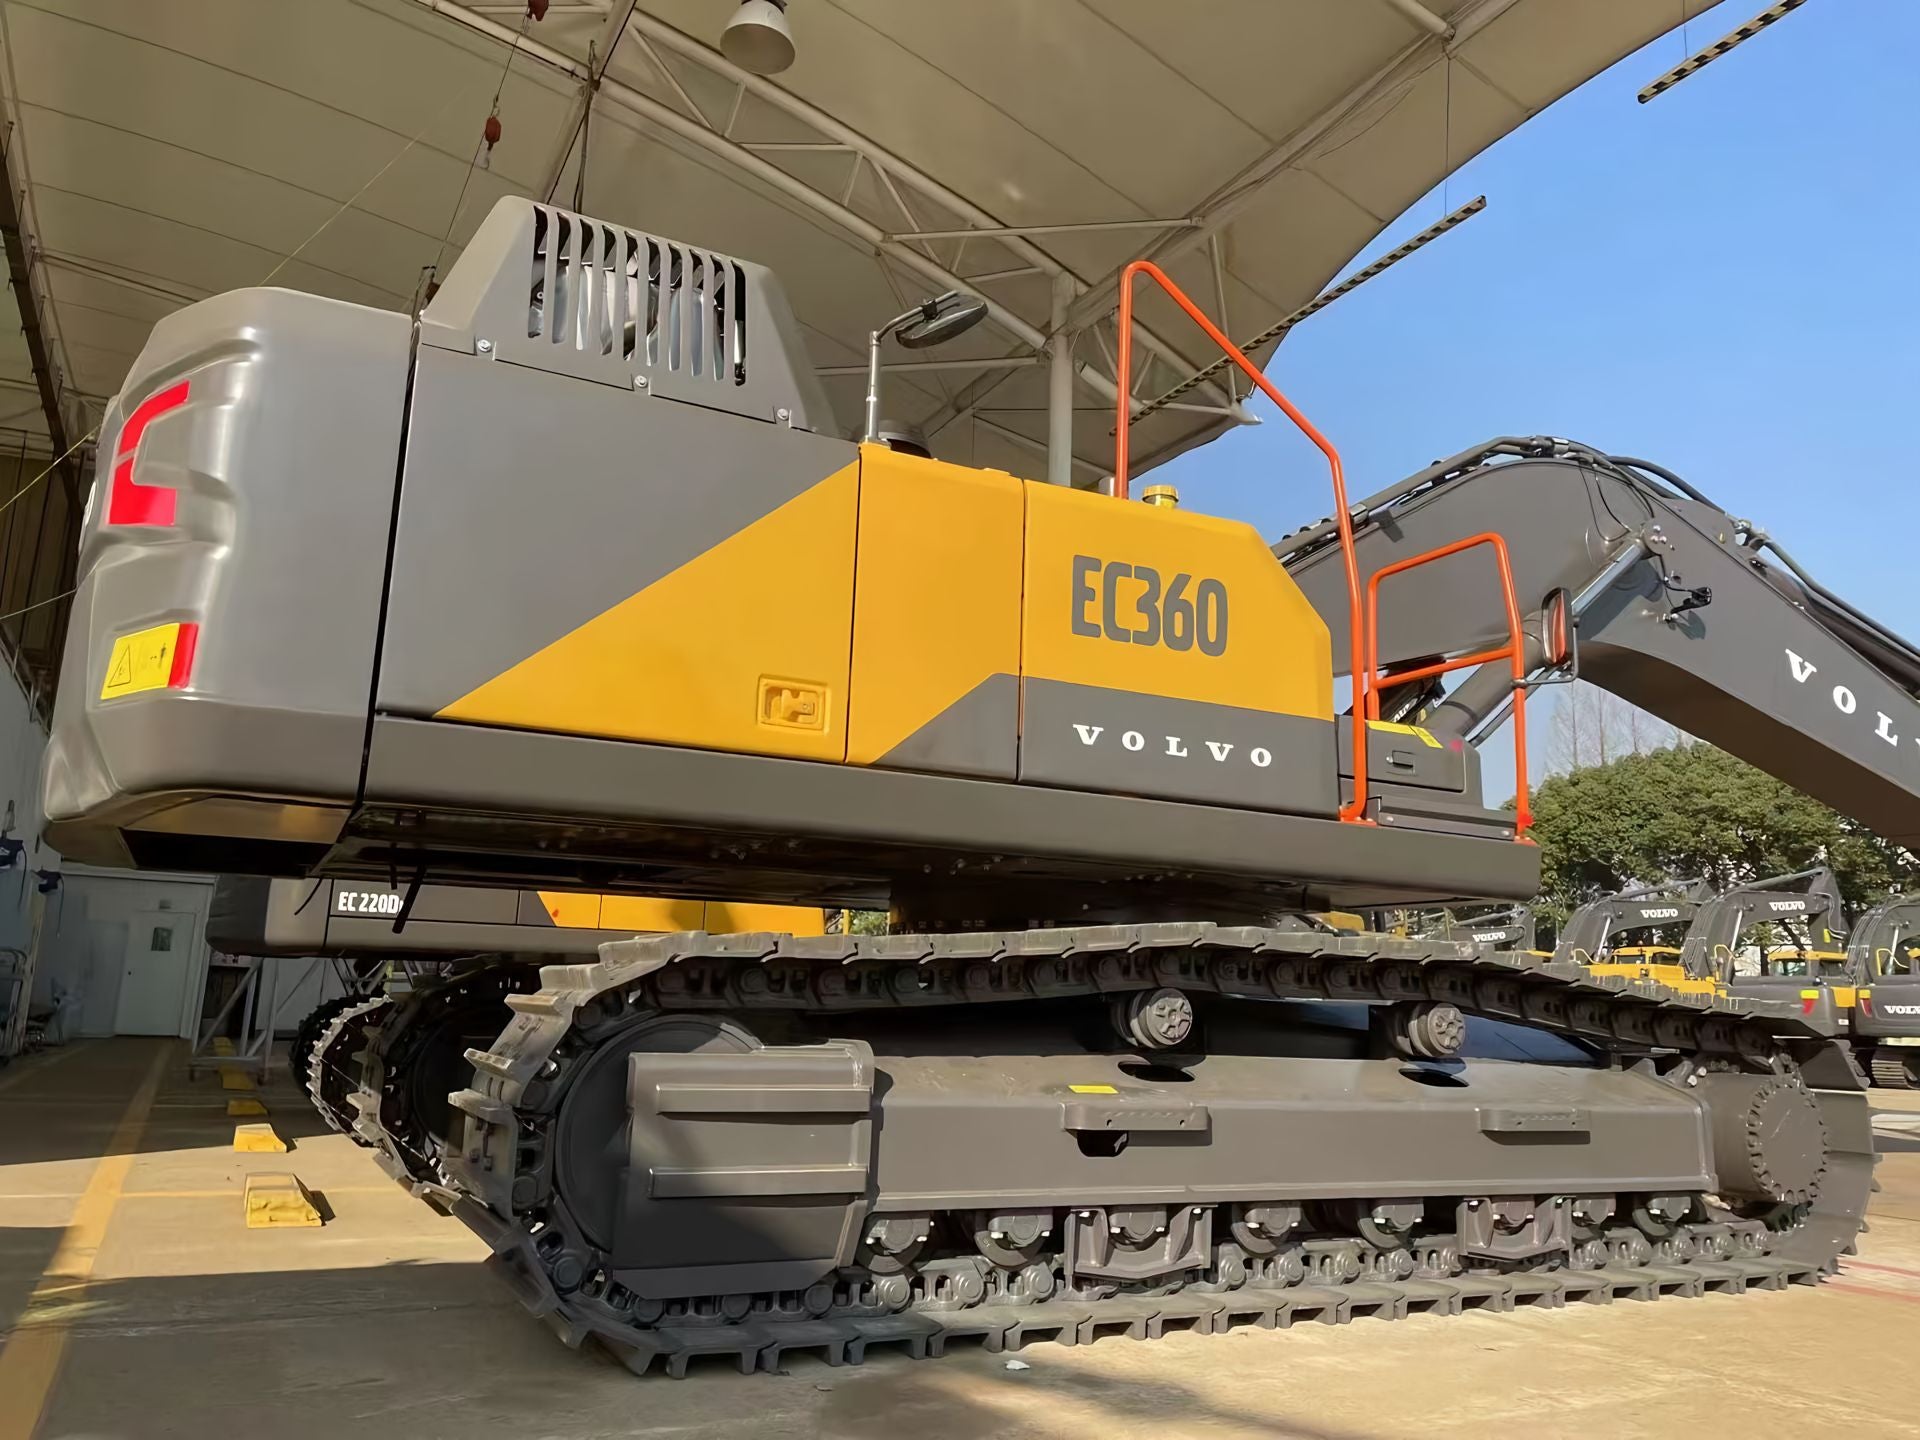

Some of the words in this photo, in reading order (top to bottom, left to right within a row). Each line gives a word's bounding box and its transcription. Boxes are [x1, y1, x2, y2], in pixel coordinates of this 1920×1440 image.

[1071, 554, 1228, 657] EC360
[1785, 648, 1920, 747] VOL
[1072, 723, 1272, 767] VOLVO
[1640, 908, 1679, 919] VOLVO
[1768, 900, 1806, 911] VOLVO
[1472, 931, 1506, 943] VOLVO
